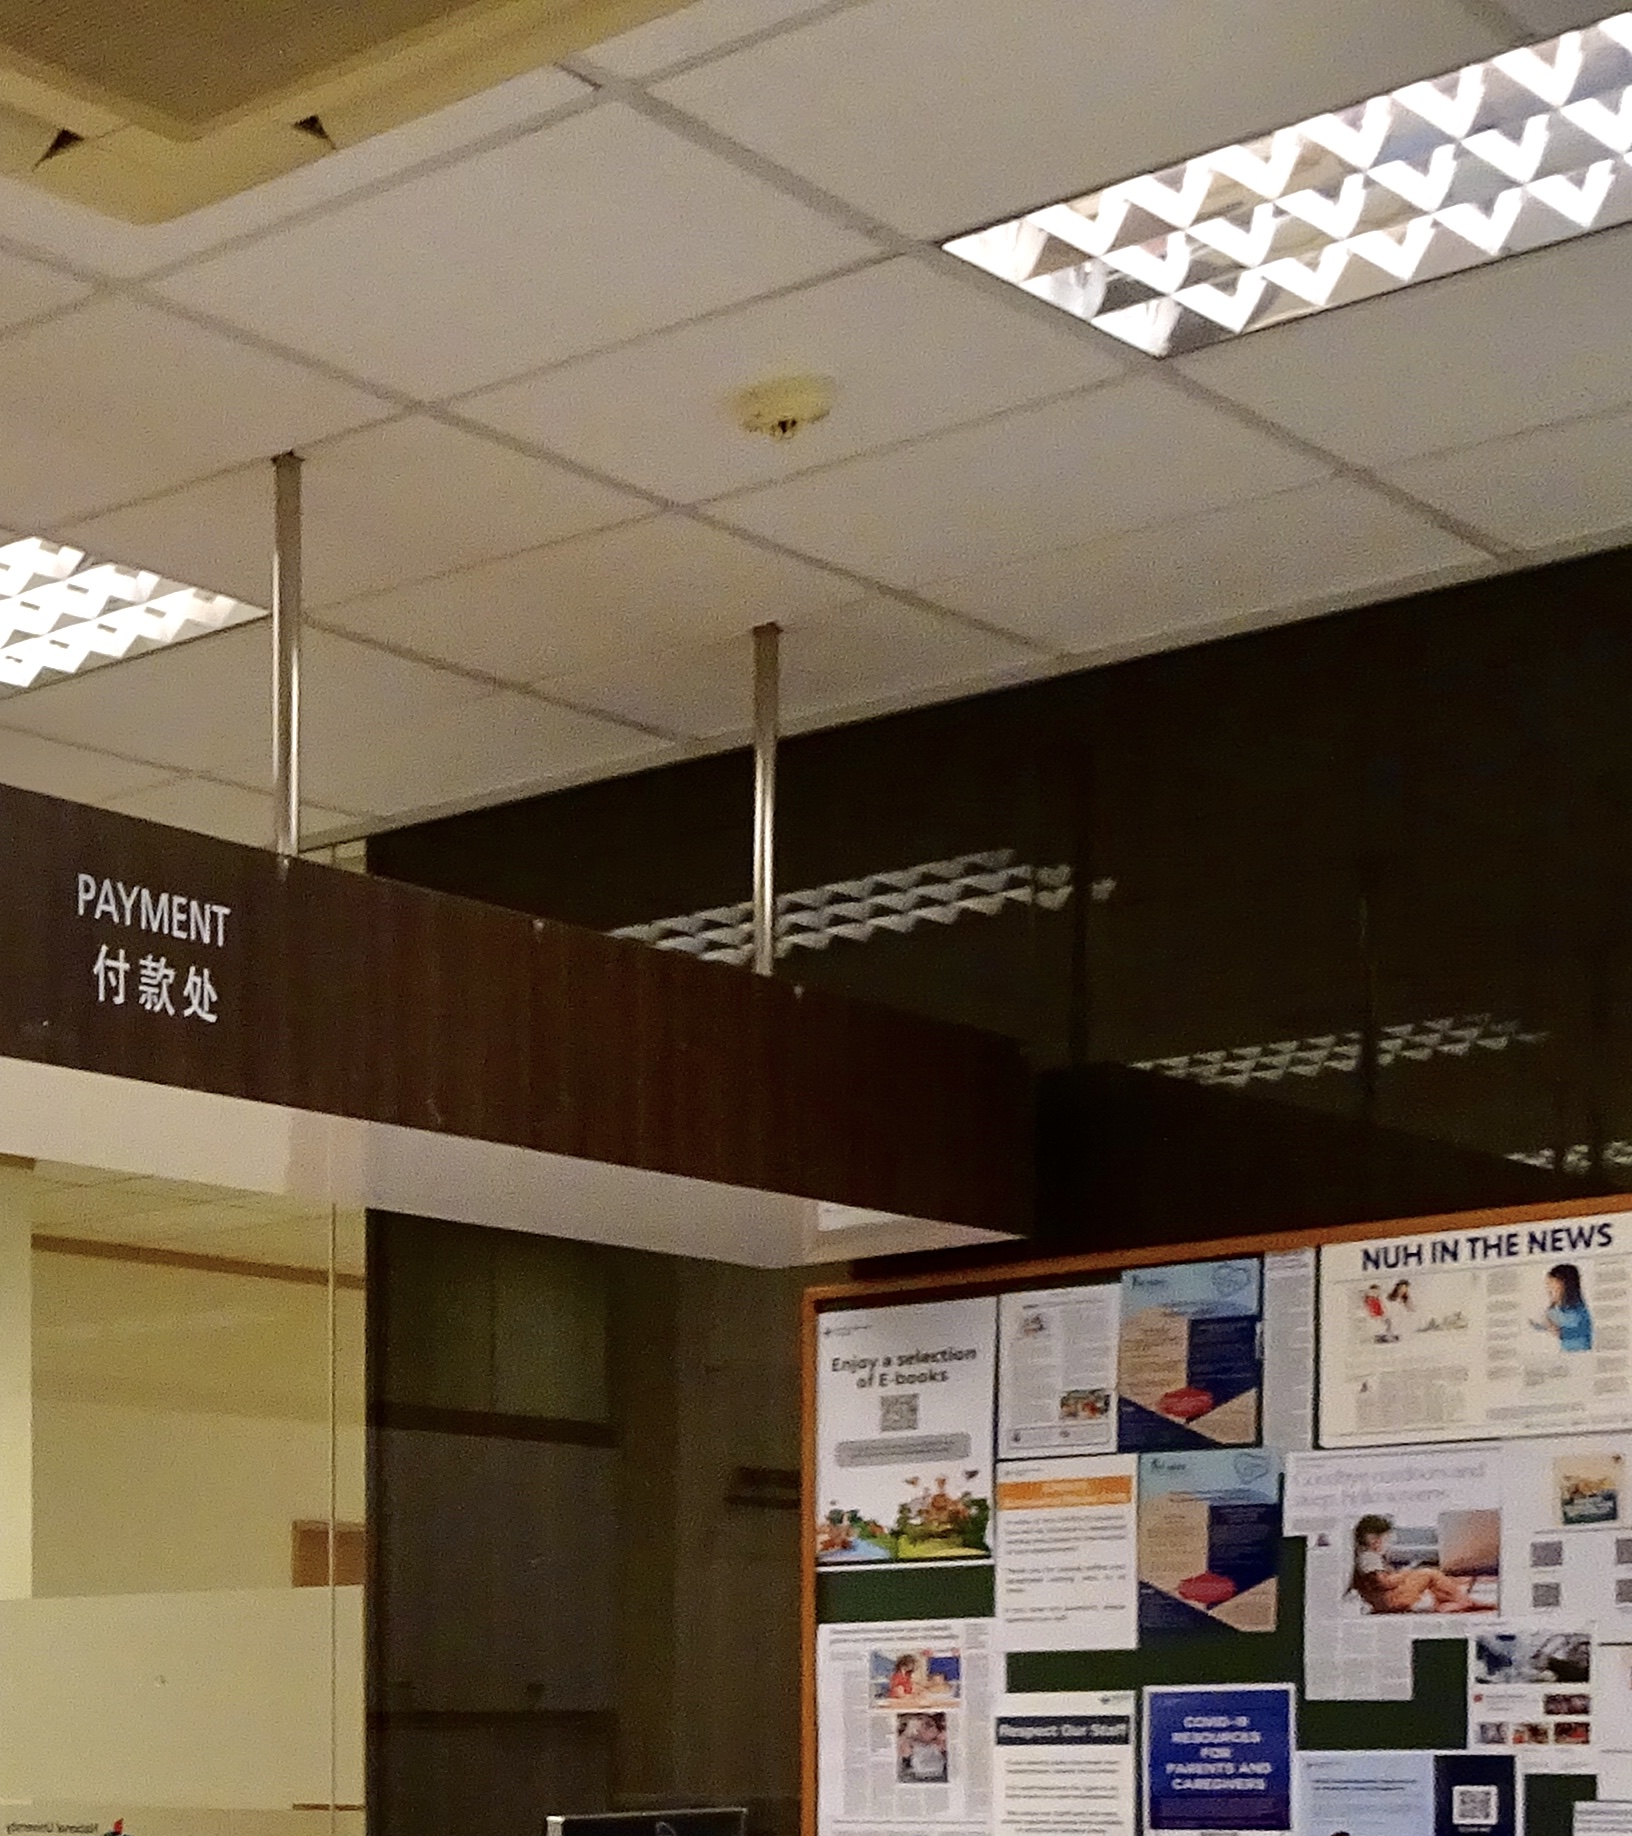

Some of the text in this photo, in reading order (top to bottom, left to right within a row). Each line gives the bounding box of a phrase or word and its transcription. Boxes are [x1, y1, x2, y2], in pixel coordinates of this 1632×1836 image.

[78, 873, 231, 947] PAYMENT
[94, 944, 218, 1023] 付款处
[1362, 1223, 1613, 1271] NUH IN THE NEWS
[831, 1348, 977, 1373] Enjoy a selection
[856, 1370, 948, 1389] of E-books
[999, 1722, 1127, 1740] Respect Our Staff
